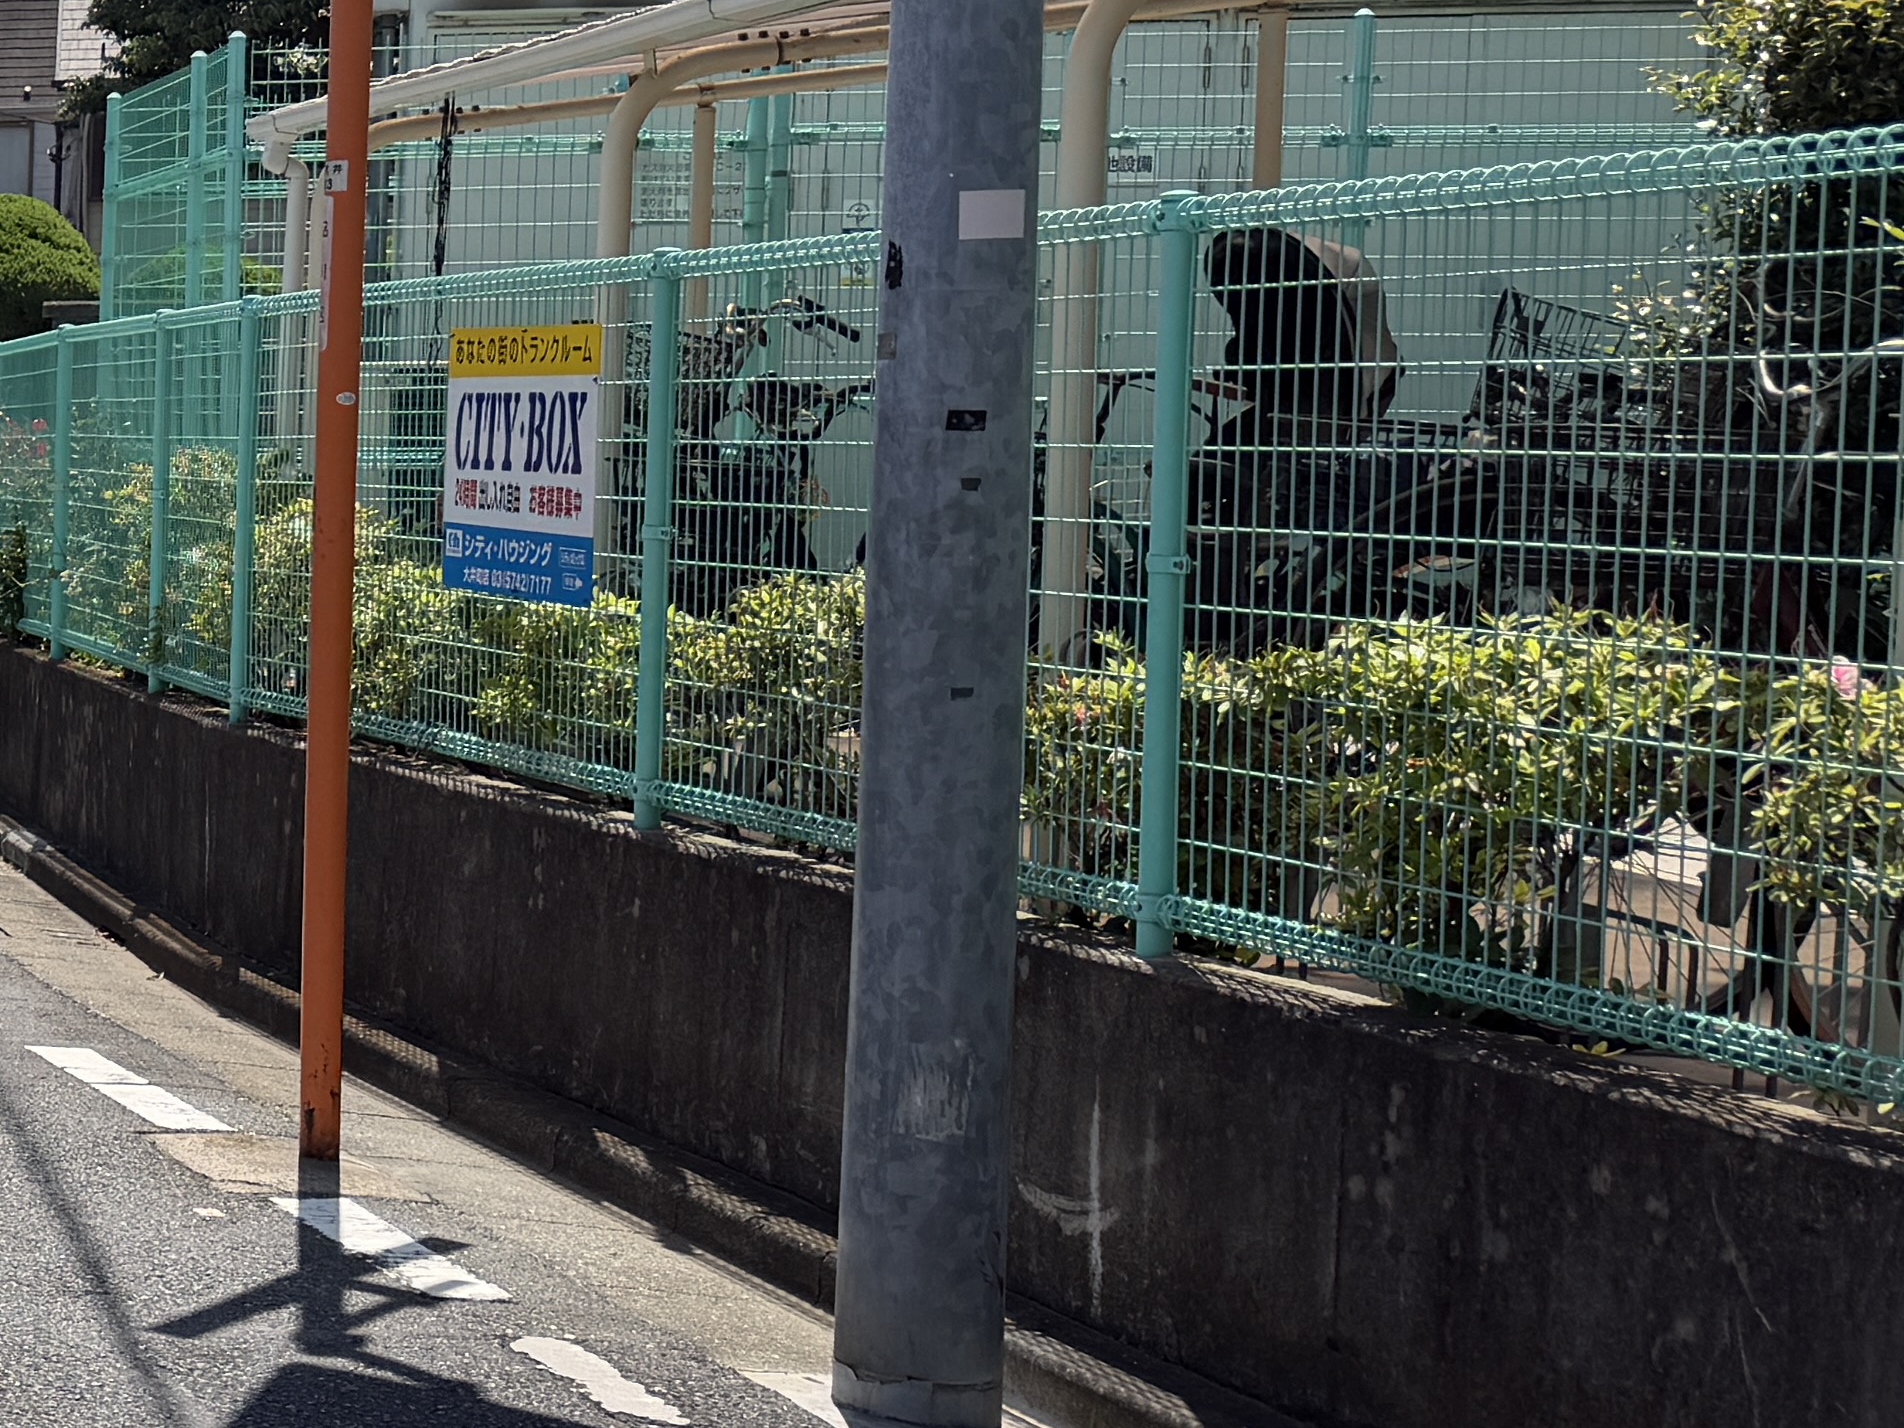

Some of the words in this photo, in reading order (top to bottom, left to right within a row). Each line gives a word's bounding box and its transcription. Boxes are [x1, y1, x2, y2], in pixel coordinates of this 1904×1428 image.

[455, 334, 593, 365] あなたの街のトランクルーム
